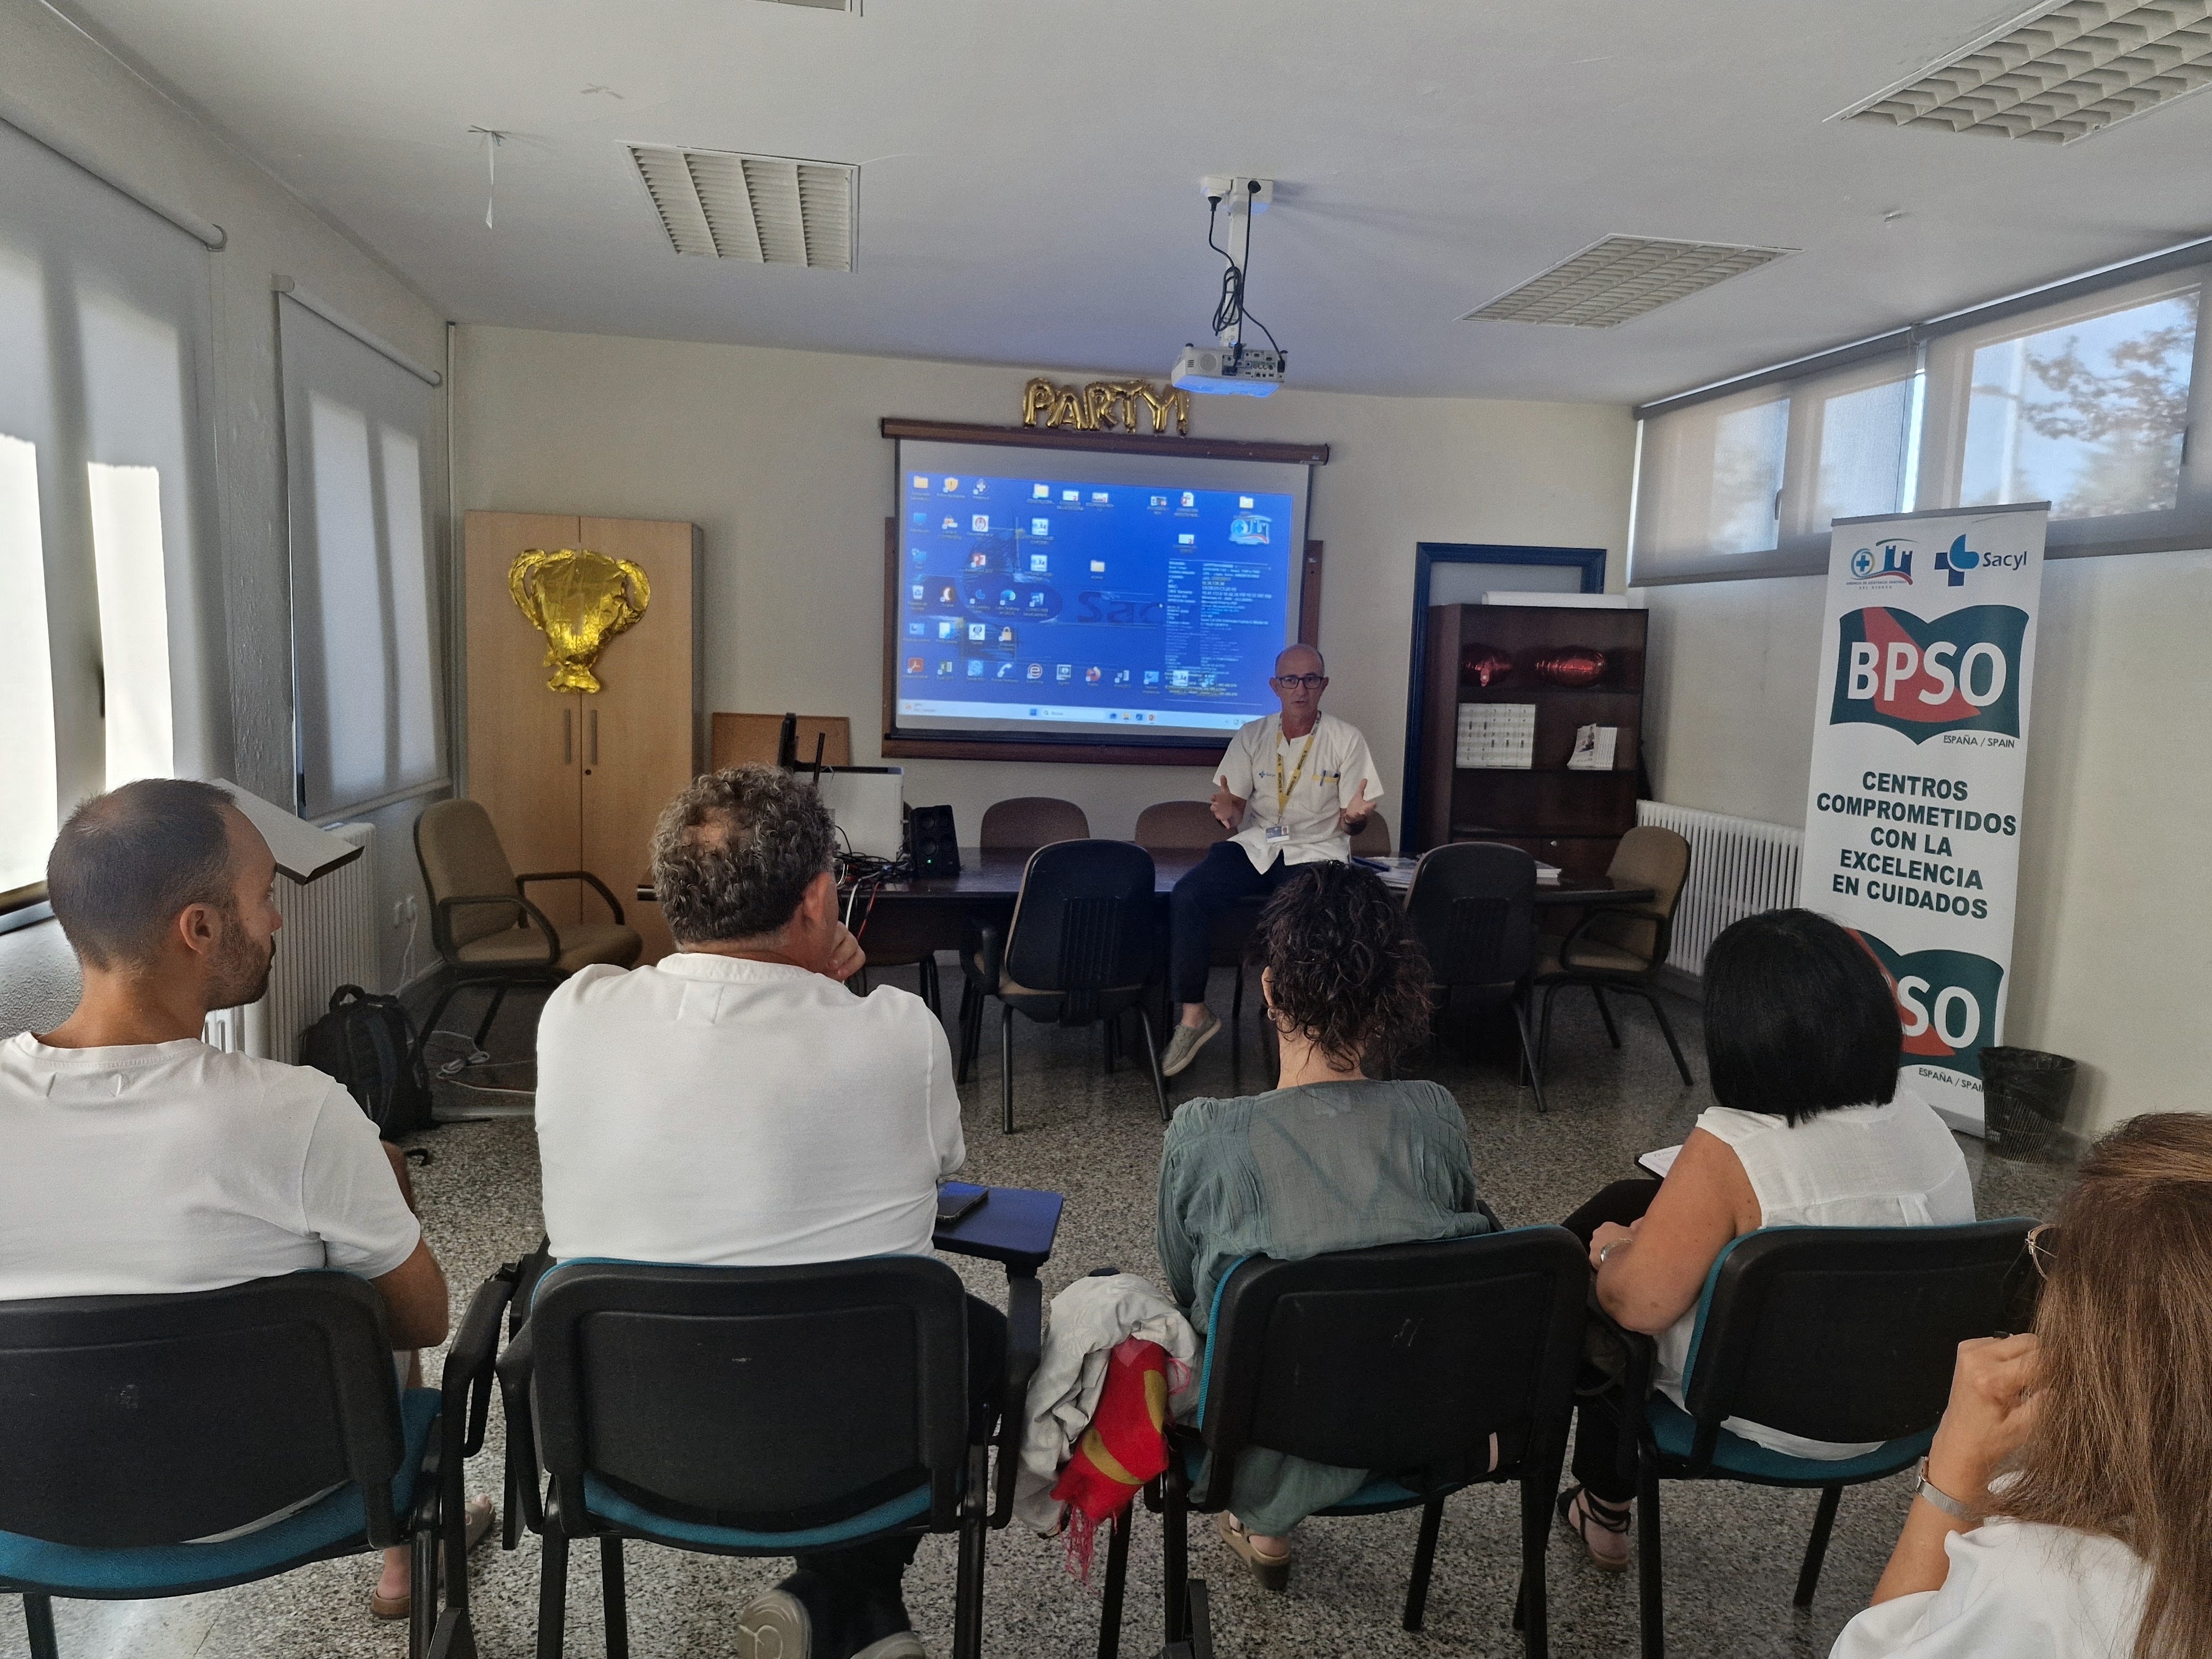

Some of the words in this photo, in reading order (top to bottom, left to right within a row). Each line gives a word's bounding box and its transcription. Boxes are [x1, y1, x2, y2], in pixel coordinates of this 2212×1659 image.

[1983, 551, 2027, 571] Sacyl
[1848, 641, 2006, 707] BPSO
[1943, 734, 1978, 745] ESPAÑA
[1980, 737, 1986, 747] /
[1987, 738, 2015, 748] SPAIN
[1863, 771, 1968, 801] CENTROS
[1817, 792, 2016, 836] COMPROMETIDOS
[1871, 827, 1917, 851] CON
[1924, 834, 1952, 857] LA
[1840, 848, 1984, 890] EXCELENCIA
[1832, 874, 1859, 896] EN
[1867, 880, 1988, 919] CUIDADOS
[1897, 975, 1980, 1048] SO
[1918, 1067, 1953, 1084] ESPAÑA
[1961, 1079, 1984, 1093] SPAI
